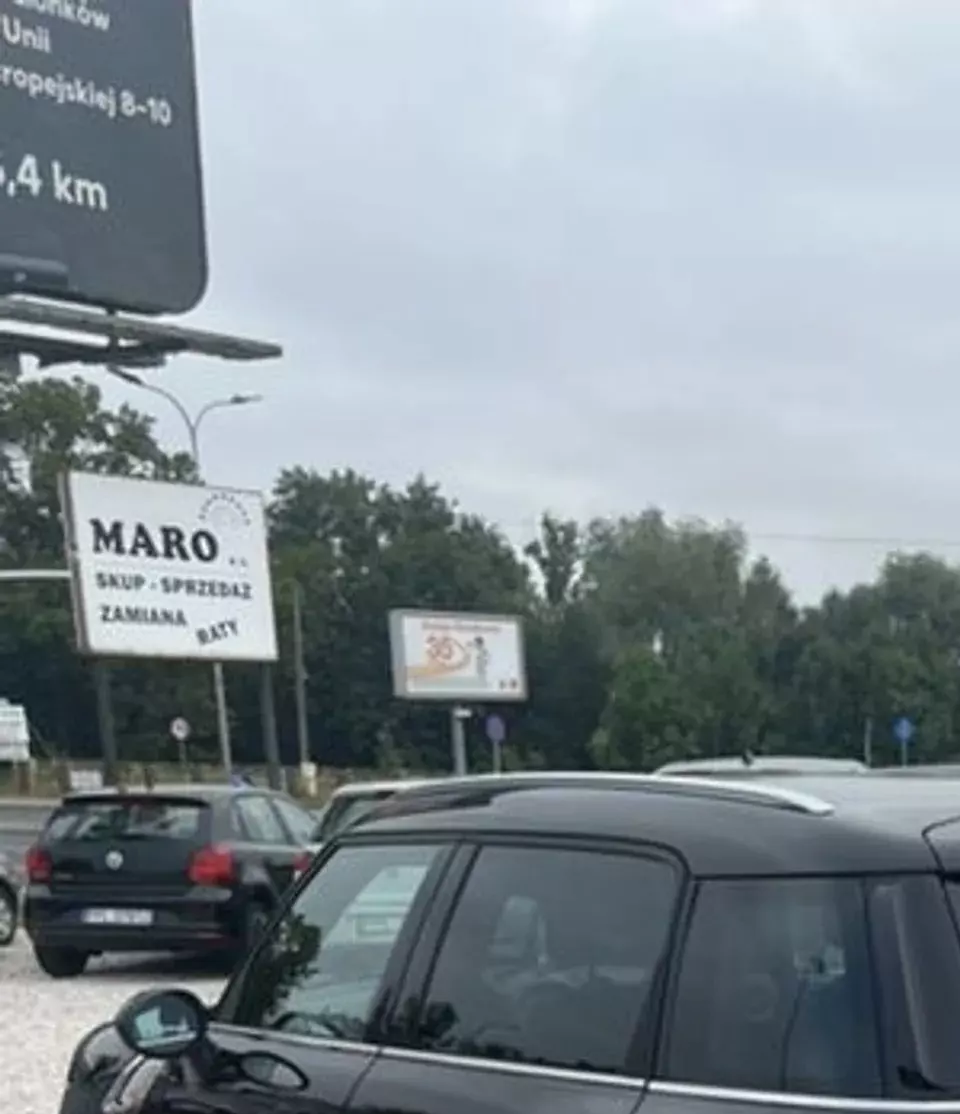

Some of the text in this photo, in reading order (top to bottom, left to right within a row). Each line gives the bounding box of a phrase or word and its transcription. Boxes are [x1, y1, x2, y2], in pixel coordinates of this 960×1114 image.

[3, 13, 52, 54] Unii
[0, 64, 172, 126] ropejskiej 8-10
[0, 153, 109, 211] ,4 km
[90, 517, 219, 562] MARO
[96, 572, 146, 591] SKUP
[101, 604, 188, 627] ZAMIANA
[196, 618, 239, 646] RATY
